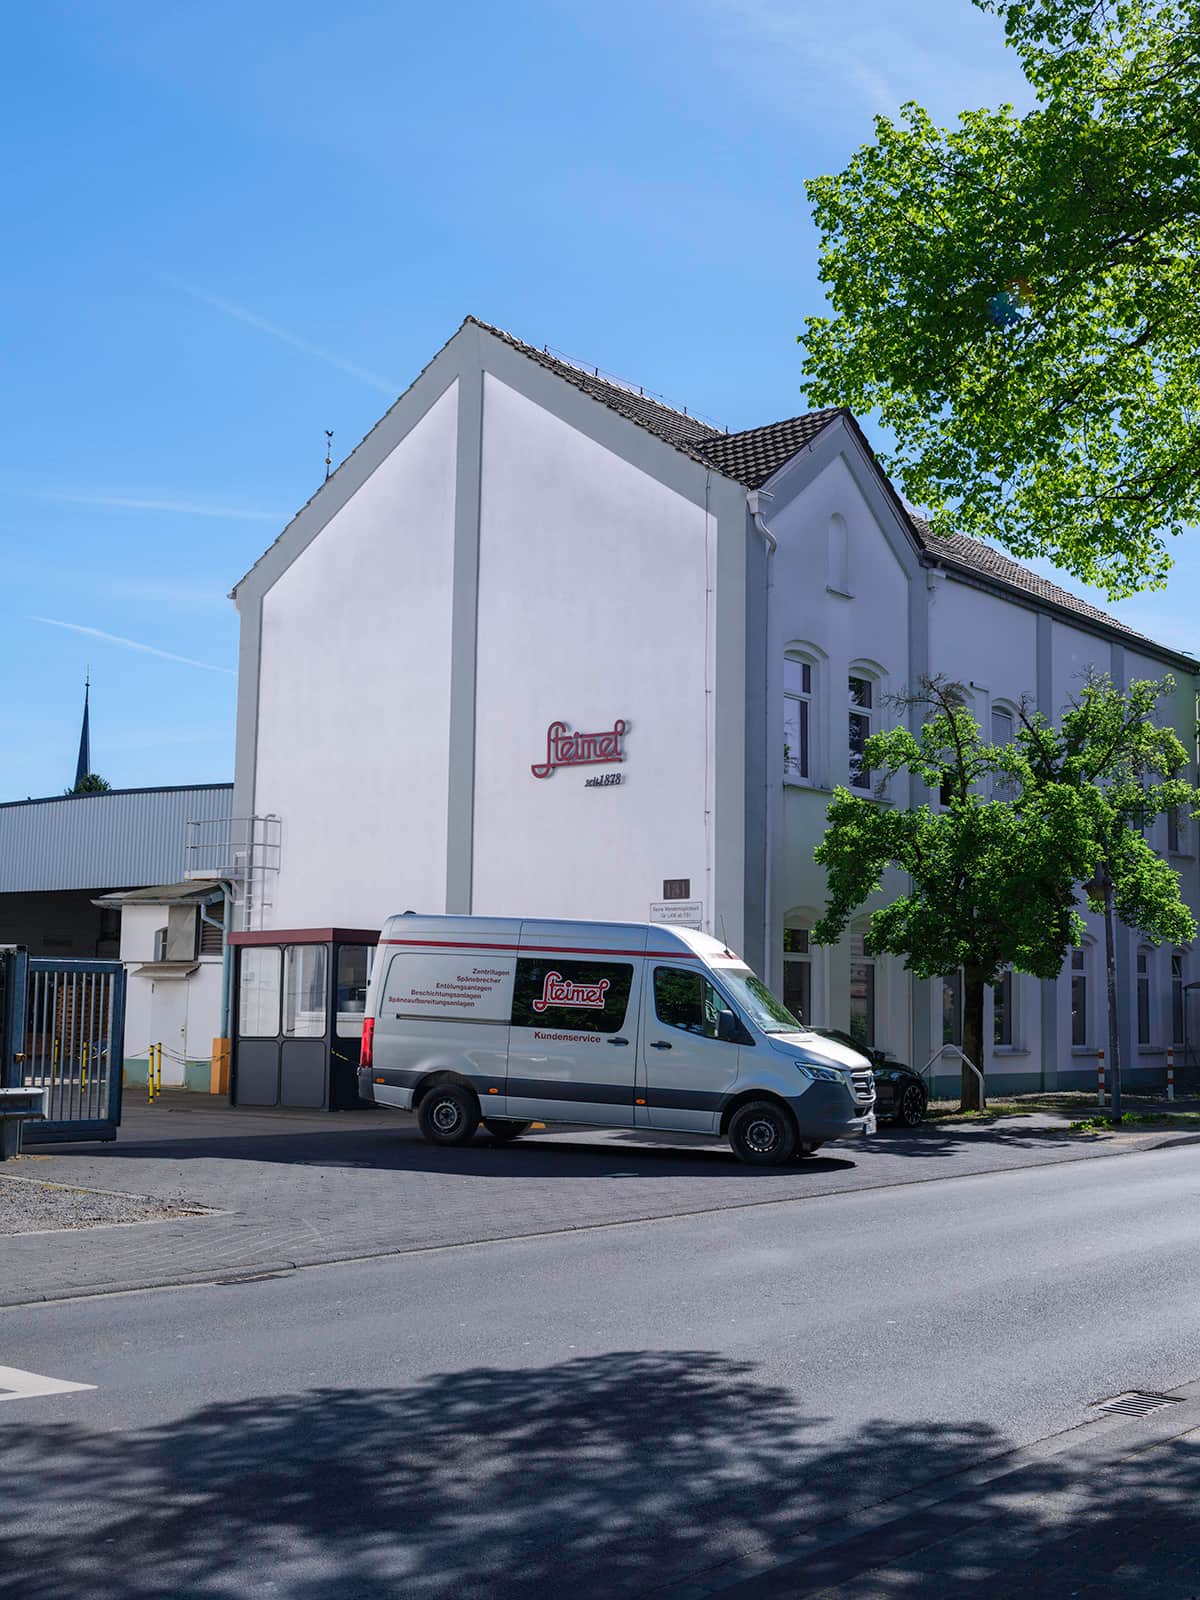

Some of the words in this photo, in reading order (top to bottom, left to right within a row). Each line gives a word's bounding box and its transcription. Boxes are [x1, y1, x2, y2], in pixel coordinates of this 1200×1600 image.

[531, 719, 626, 778] Steimel
[472, 968, 510, 976] Zentrifugen
[436, 982, 492, 991] Entölungsanlagen
[533, 971, 610, 1012] Steimel
[410, 989, 481, 999] Beschichtungsanlagen
[534, 1031, 601, 1043] Kundenservice
